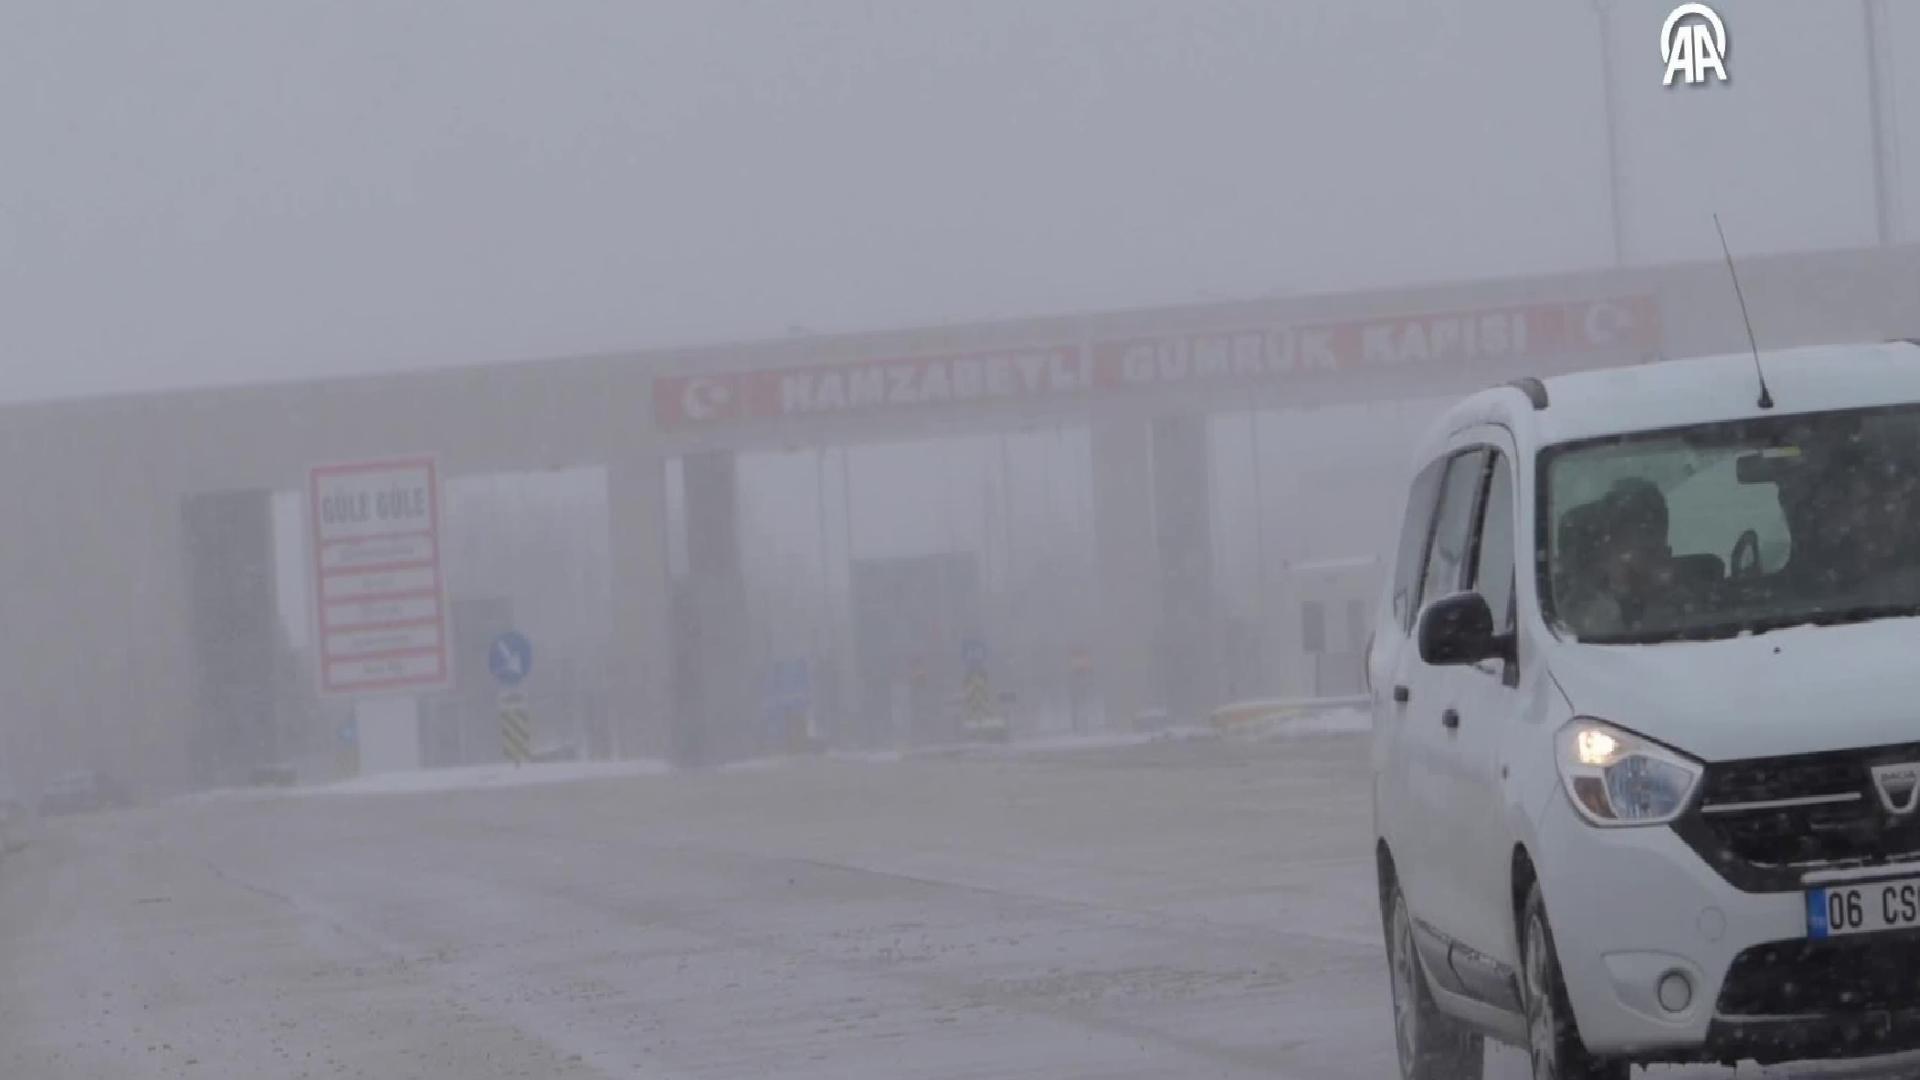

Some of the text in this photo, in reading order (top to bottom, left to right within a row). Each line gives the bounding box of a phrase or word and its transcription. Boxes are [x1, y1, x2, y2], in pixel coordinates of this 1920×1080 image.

[1362, 312, 1527, 360] KAPISI
[1829, 885, 1920, 929] 06 CS
